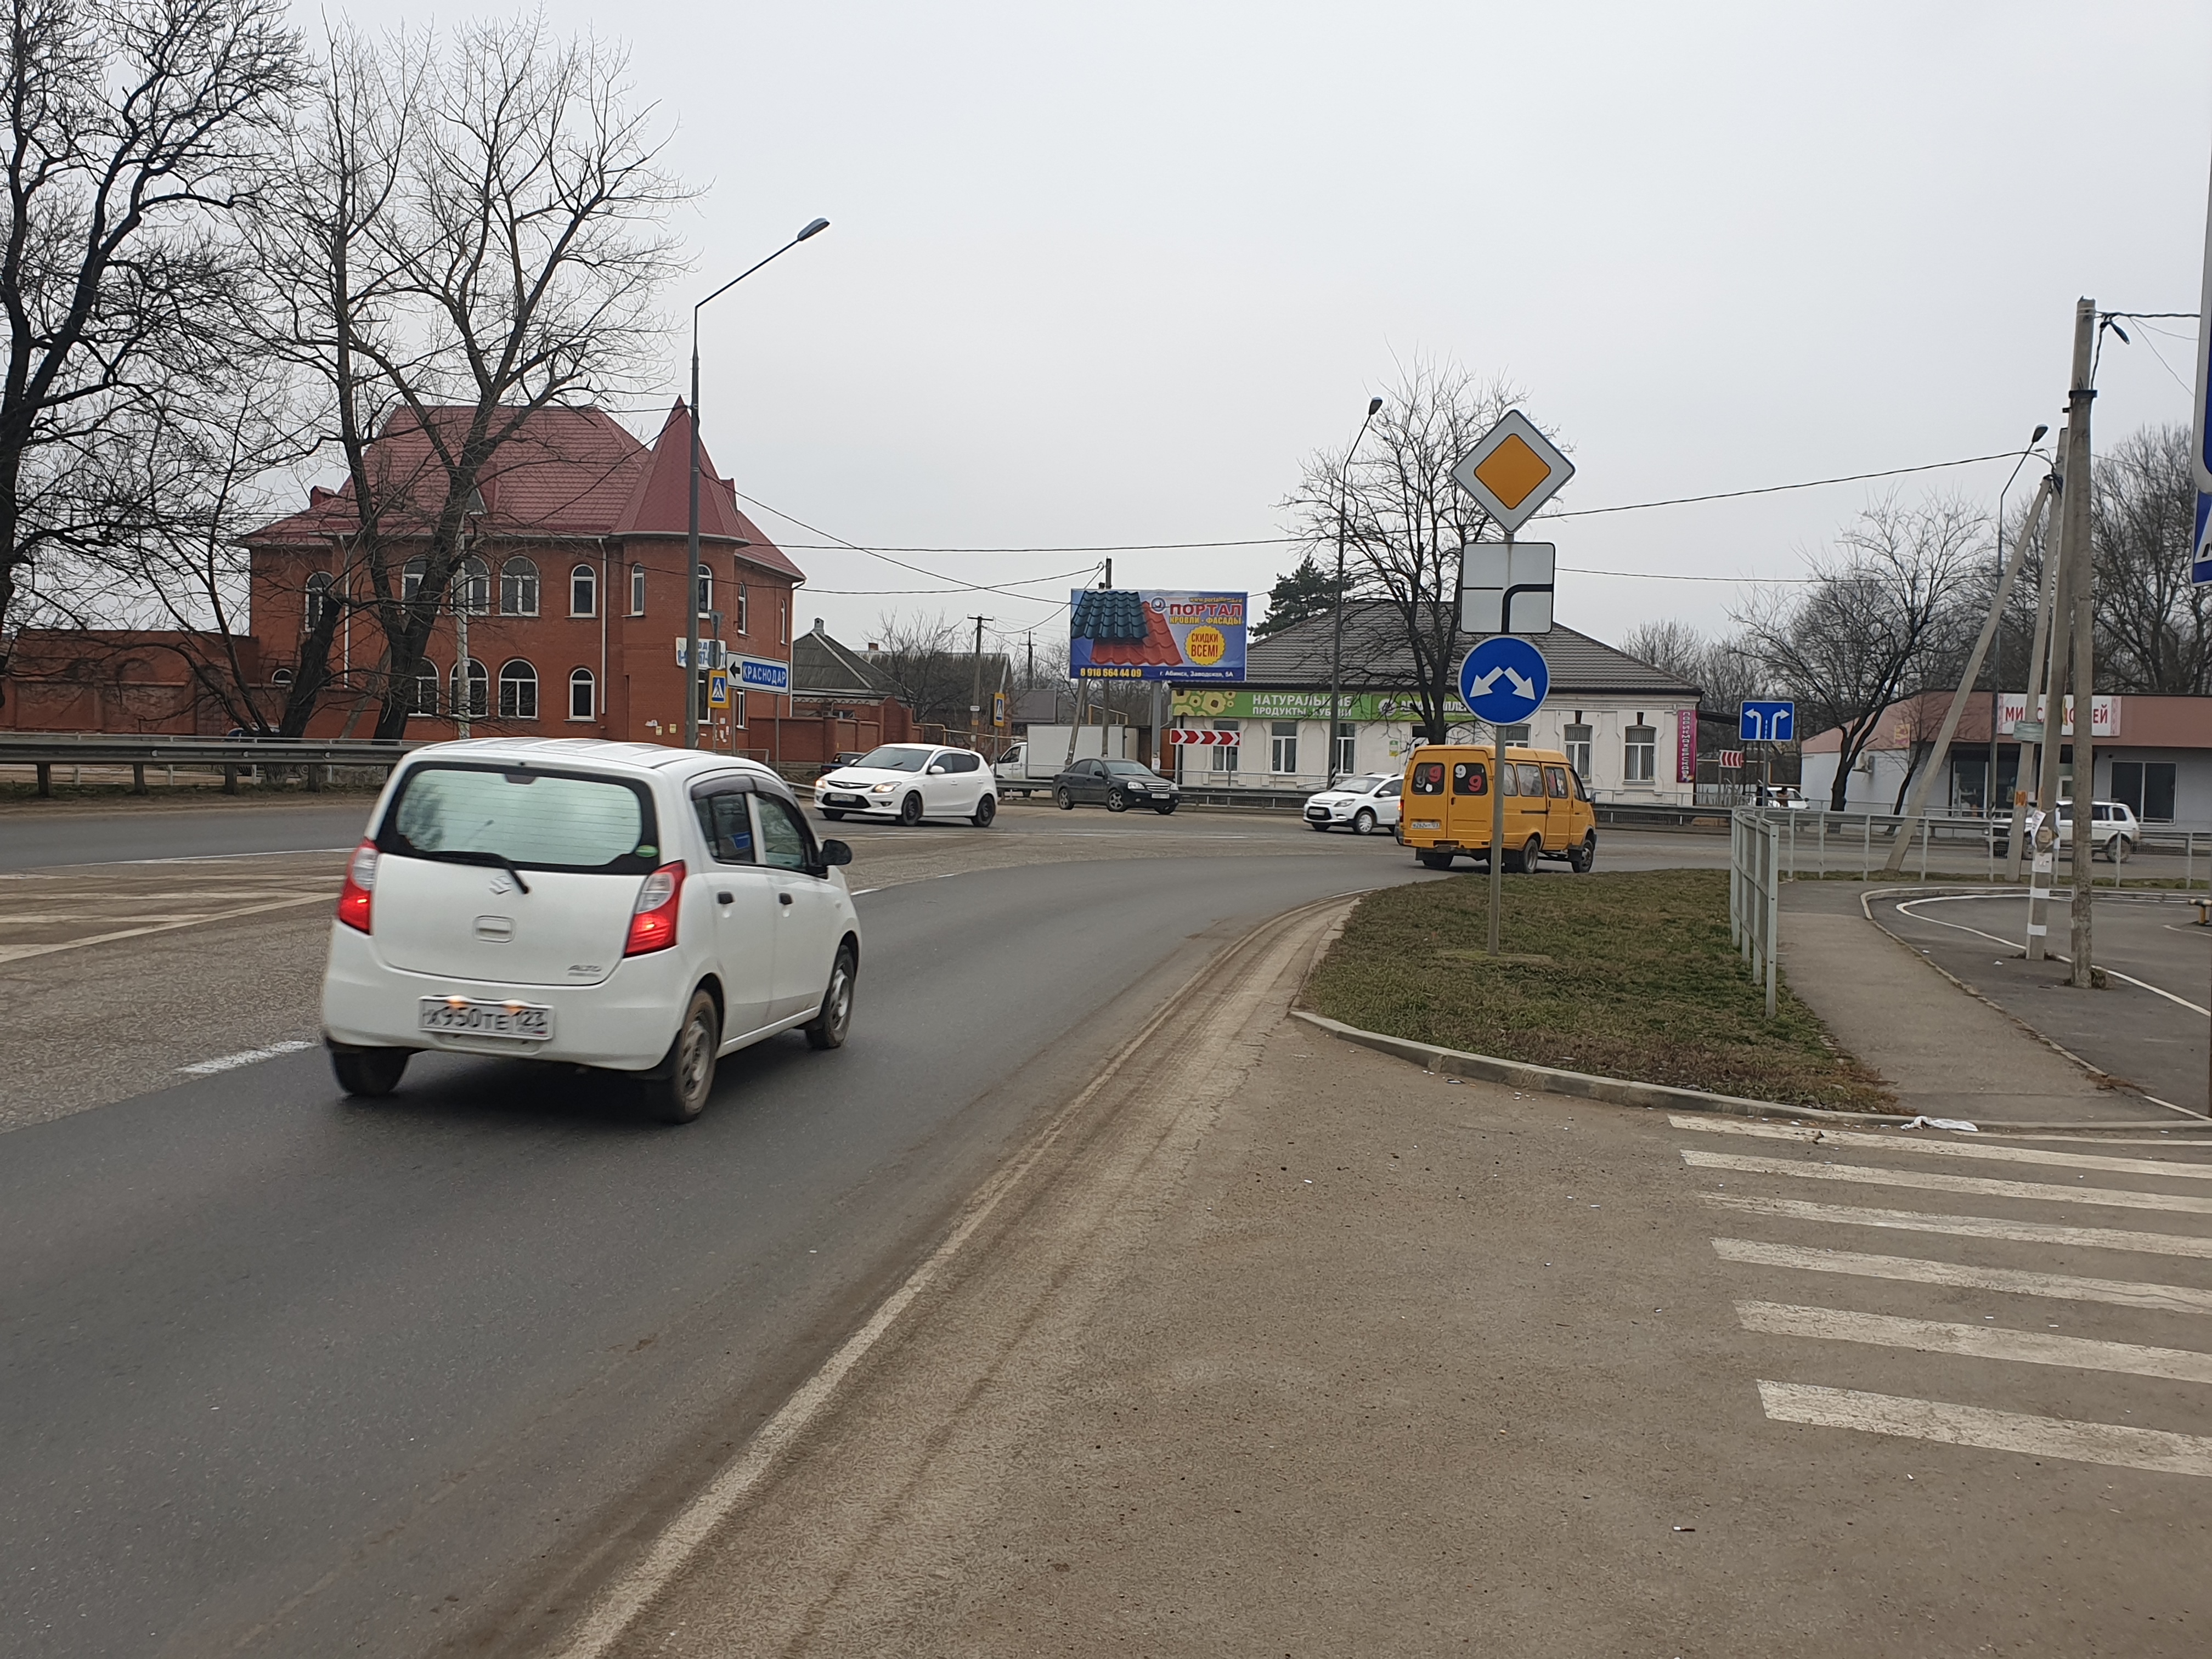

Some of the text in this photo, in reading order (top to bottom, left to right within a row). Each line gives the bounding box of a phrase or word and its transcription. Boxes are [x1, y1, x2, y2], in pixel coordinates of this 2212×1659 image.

[1170, 604, 1242, 616] ПОРТАЛ
[1191, 633, 1218, 643] СКИДКИ
[1191, 645, 1218, 657] ВСЕМ!
[743, 665, 786, 685] КРАСНОДАР
[1087, 668, 1101, 676] 918
[1103, 668, 1118, 677] 664
[1120, 669, 1130, 677] 44
[1131, 669, 1142, 677] 09
[1253, 707, 1352, 716] ПРОДУКТЫ КУБНИ
[2005, 707, 2025, 722] МИ
[1428, 765, 1442, 782] 9
[1455, 764, 1466, 778] 9
[1468, 774, 1482, 792] 9
[512, 1010, 547, 1027] 123
